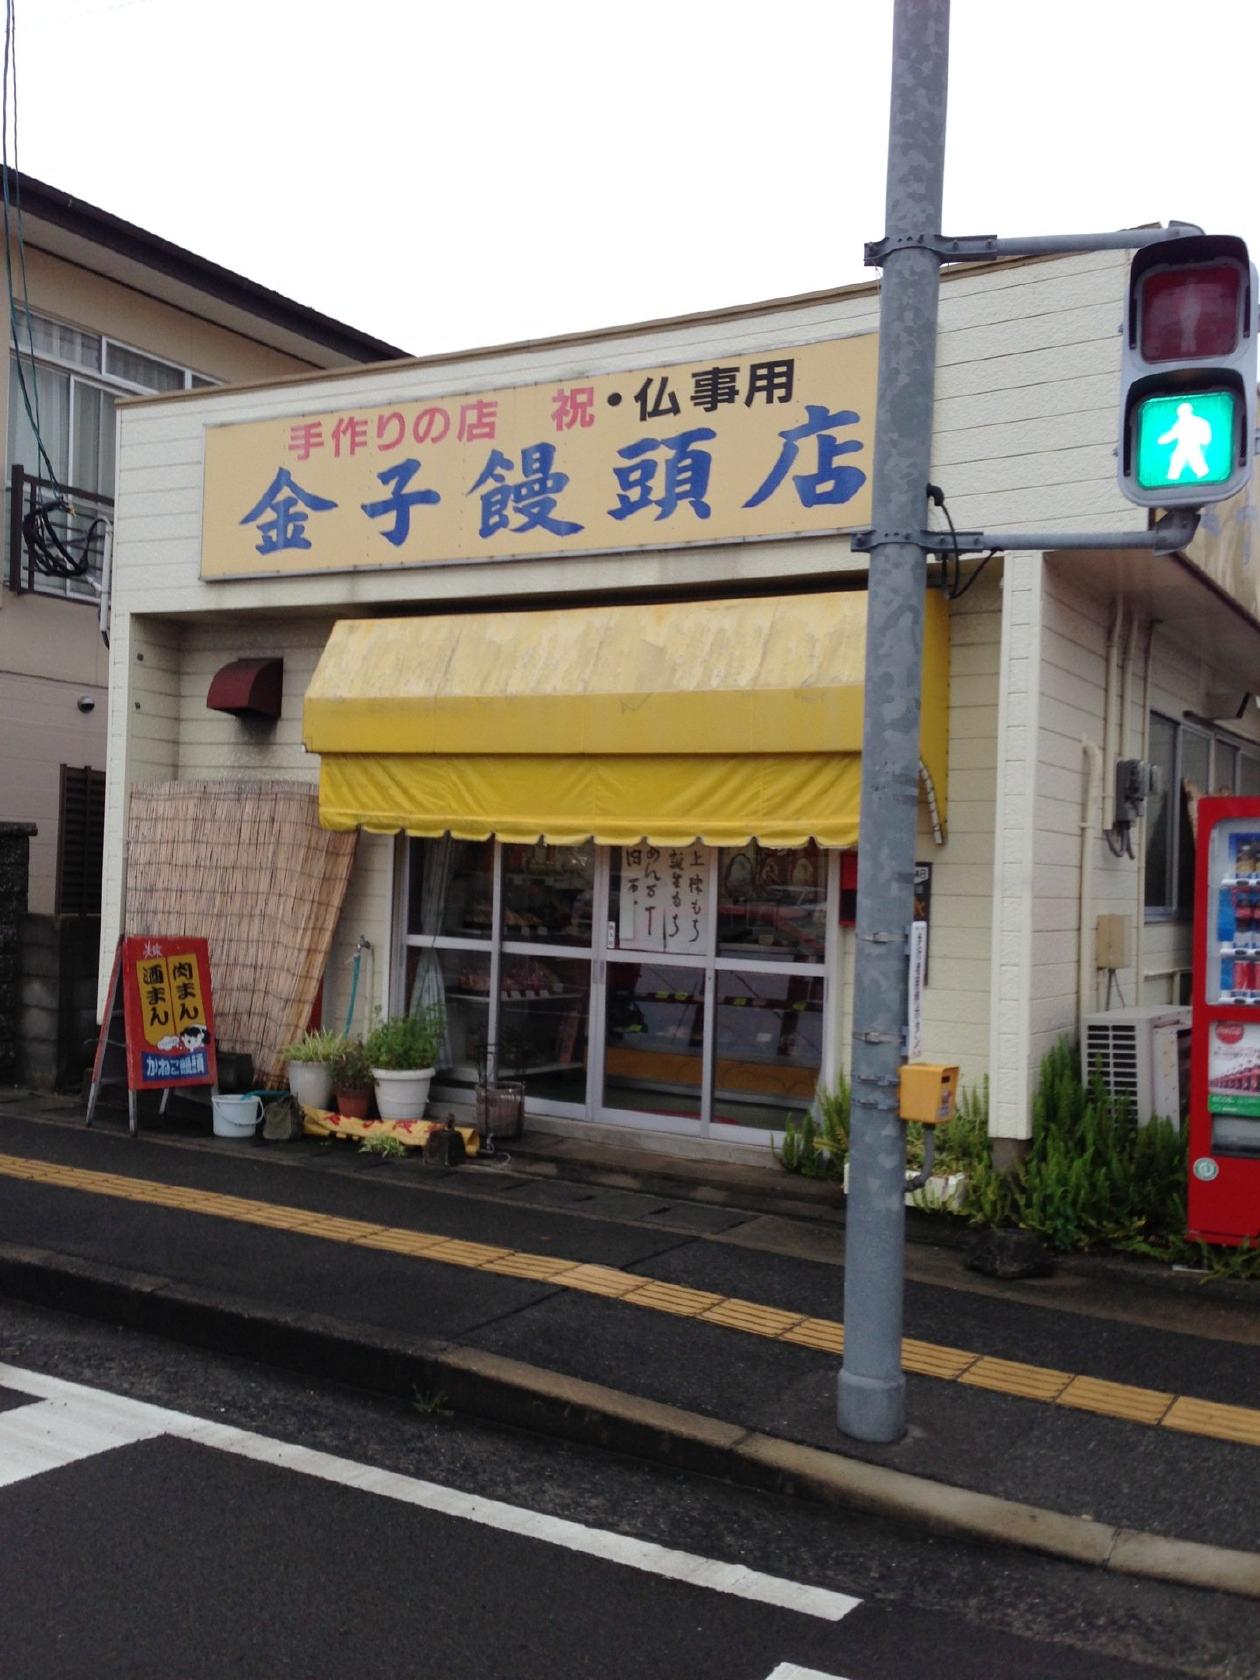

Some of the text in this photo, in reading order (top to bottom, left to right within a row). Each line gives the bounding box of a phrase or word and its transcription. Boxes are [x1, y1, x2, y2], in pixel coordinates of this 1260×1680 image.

[288, 358, 795, 461] 手作りの店 祝・仏事用
[240, 405, 867, 555] 金子饅頭店
[143, 963, 168, 1026] 酒まん
[173, 963, 198, 1020] 肉まん
